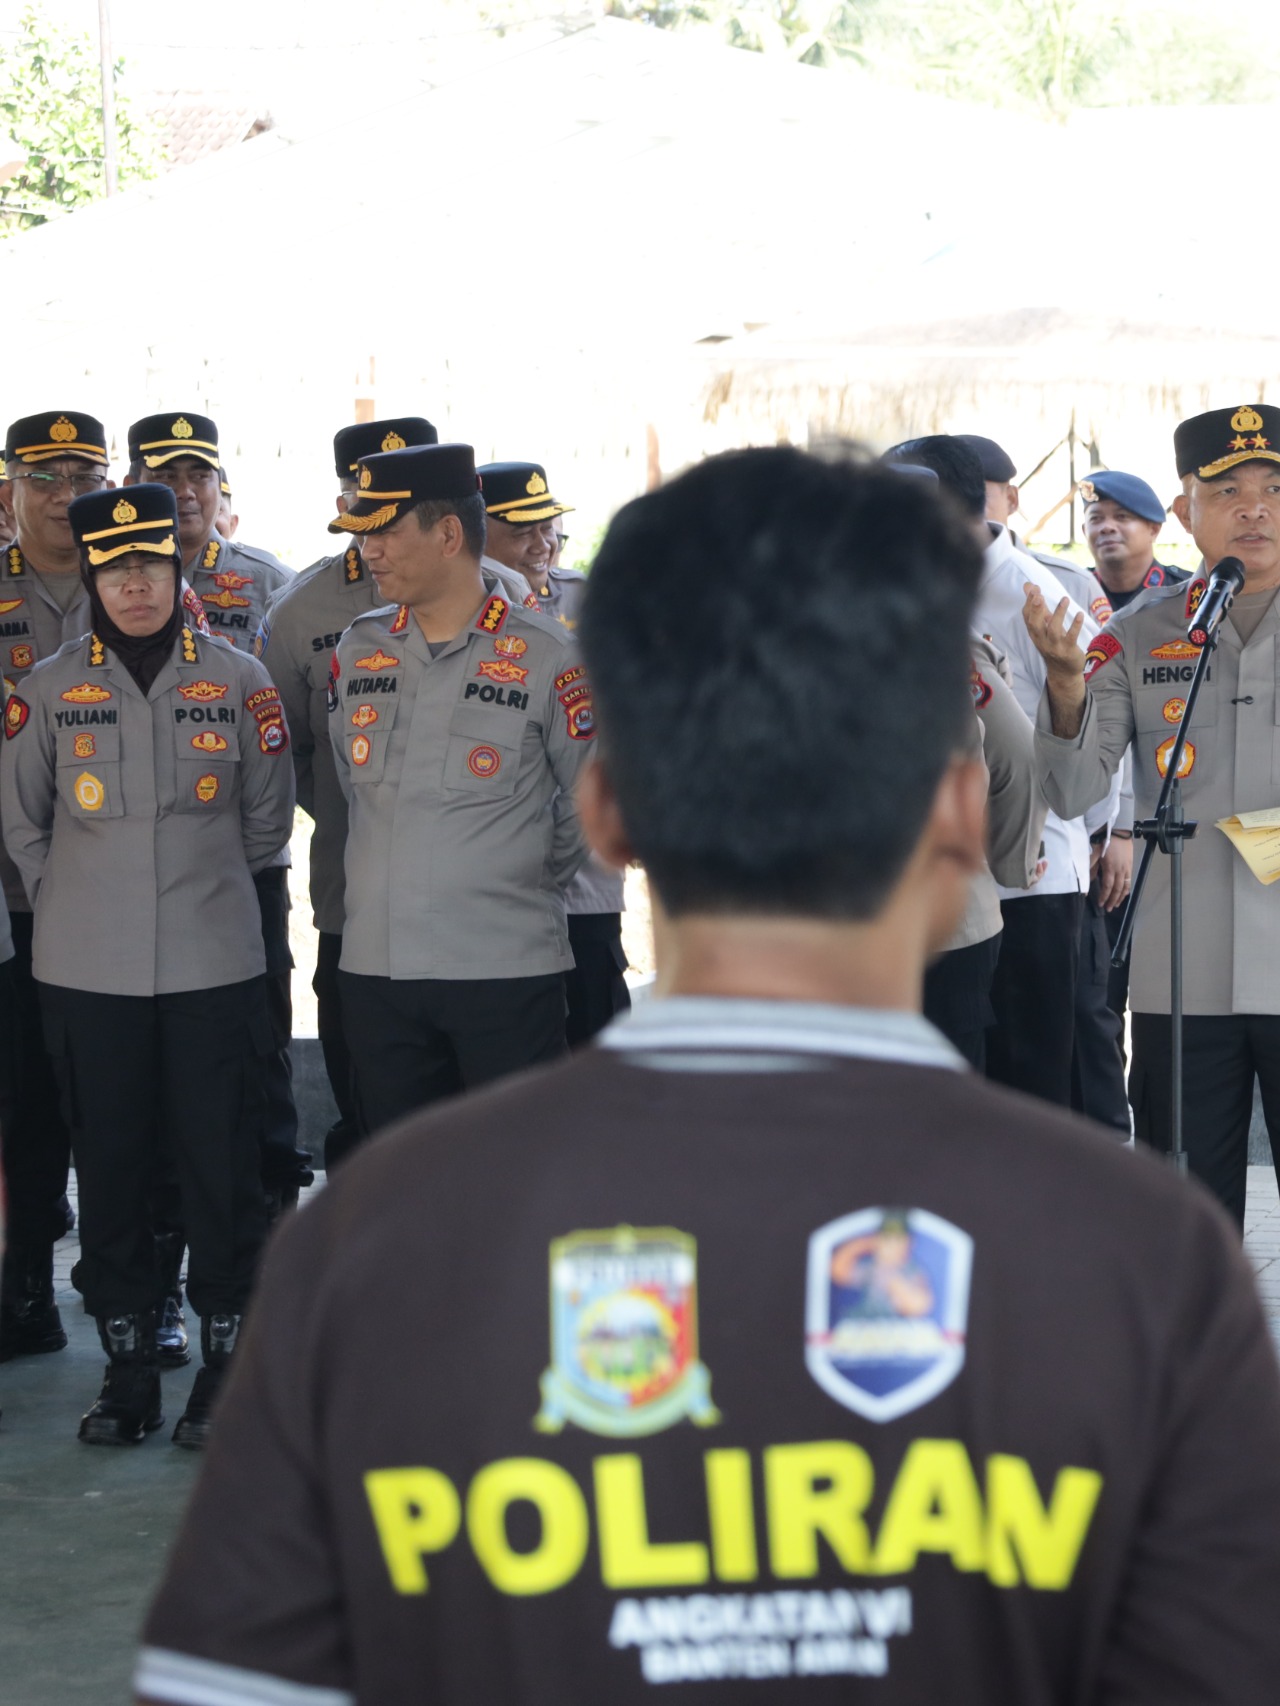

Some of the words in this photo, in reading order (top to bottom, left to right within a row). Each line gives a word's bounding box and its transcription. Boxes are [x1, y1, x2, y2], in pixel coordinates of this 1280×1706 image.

[207, 611, 250, 629] OLRI
[556, 667, 586, 688] POLD
[1143, 665, 1211, 685] HENGI
[346, 676, 397, 697] HUTAPEA
[464, 682, 530, 711] POLRI
[248, 689, 277, 709] POLDA
[55, 709, 118, 728] YULIANI
[175, 707, 236, 724] POLRI
[364, 1439, 1103, 1595] POLIRAN
